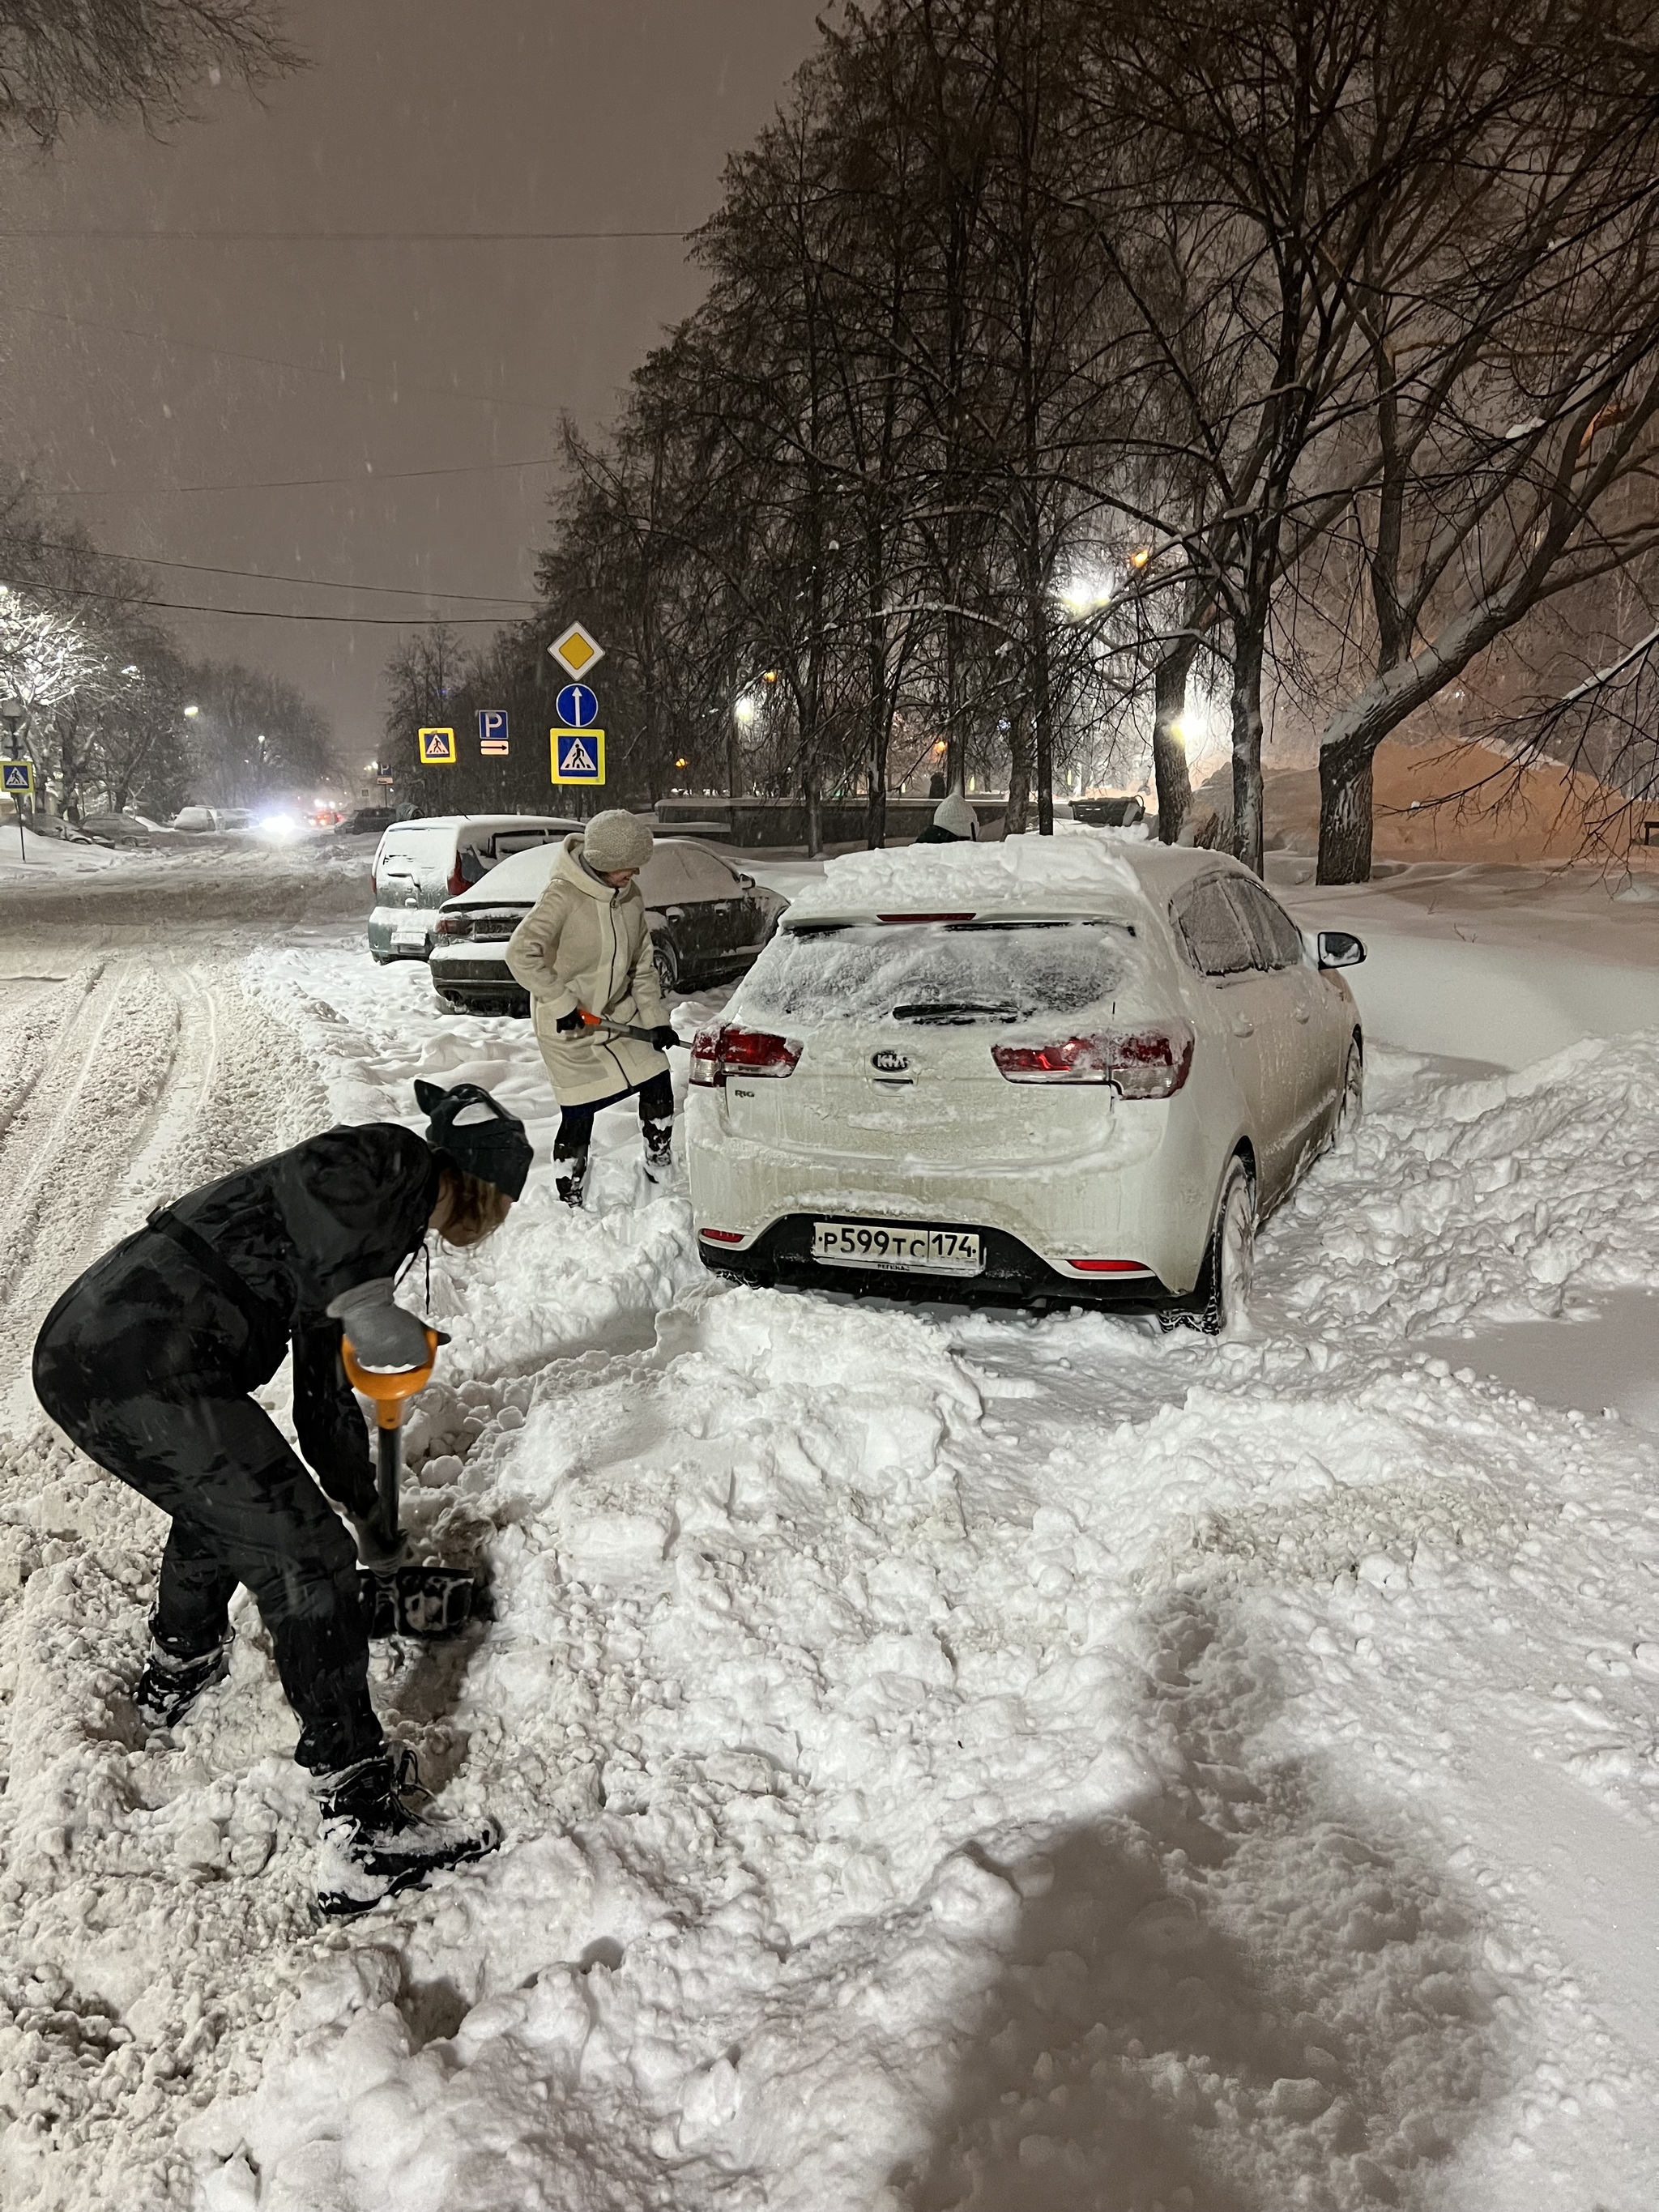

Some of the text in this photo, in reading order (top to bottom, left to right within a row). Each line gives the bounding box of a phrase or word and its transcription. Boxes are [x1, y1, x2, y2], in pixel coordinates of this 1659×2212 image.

[486, 714, 502, 737] P
[824, 1228, 972, 1258] Р599ТС 174
